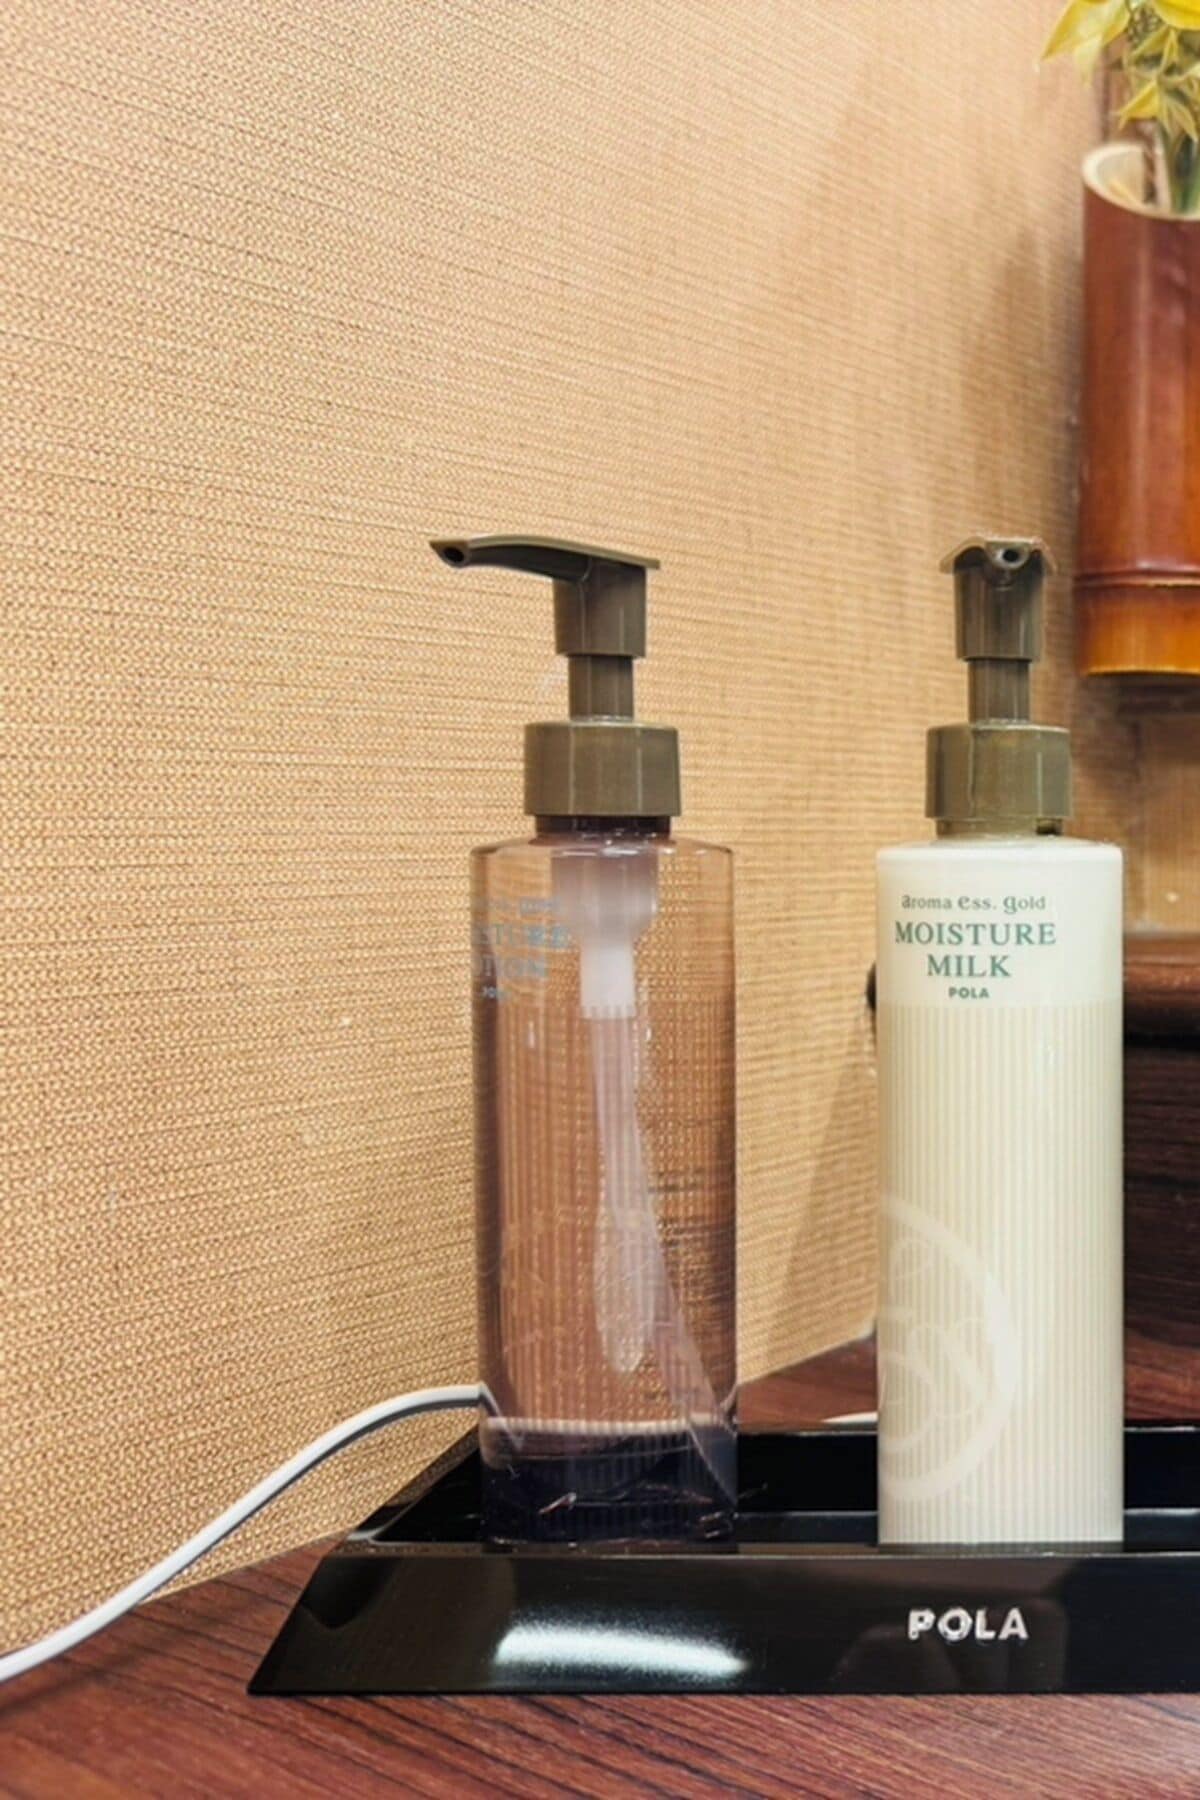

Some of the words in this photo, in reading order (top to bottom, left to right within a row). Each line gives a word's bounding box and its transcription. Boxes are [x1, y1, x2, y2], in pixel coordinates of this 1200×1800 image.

[901, 894, 952, 910] aroma
[957, 895, 998, 911] ess.
[1003, 895, 1046, 914] gold
[894, 920, 1057, 946] MOISTURE
[926, 953, 1012, 978] MILK
[948, 986, 990, 999] POLA
[908, 1606, 1030, 1641] POLA
